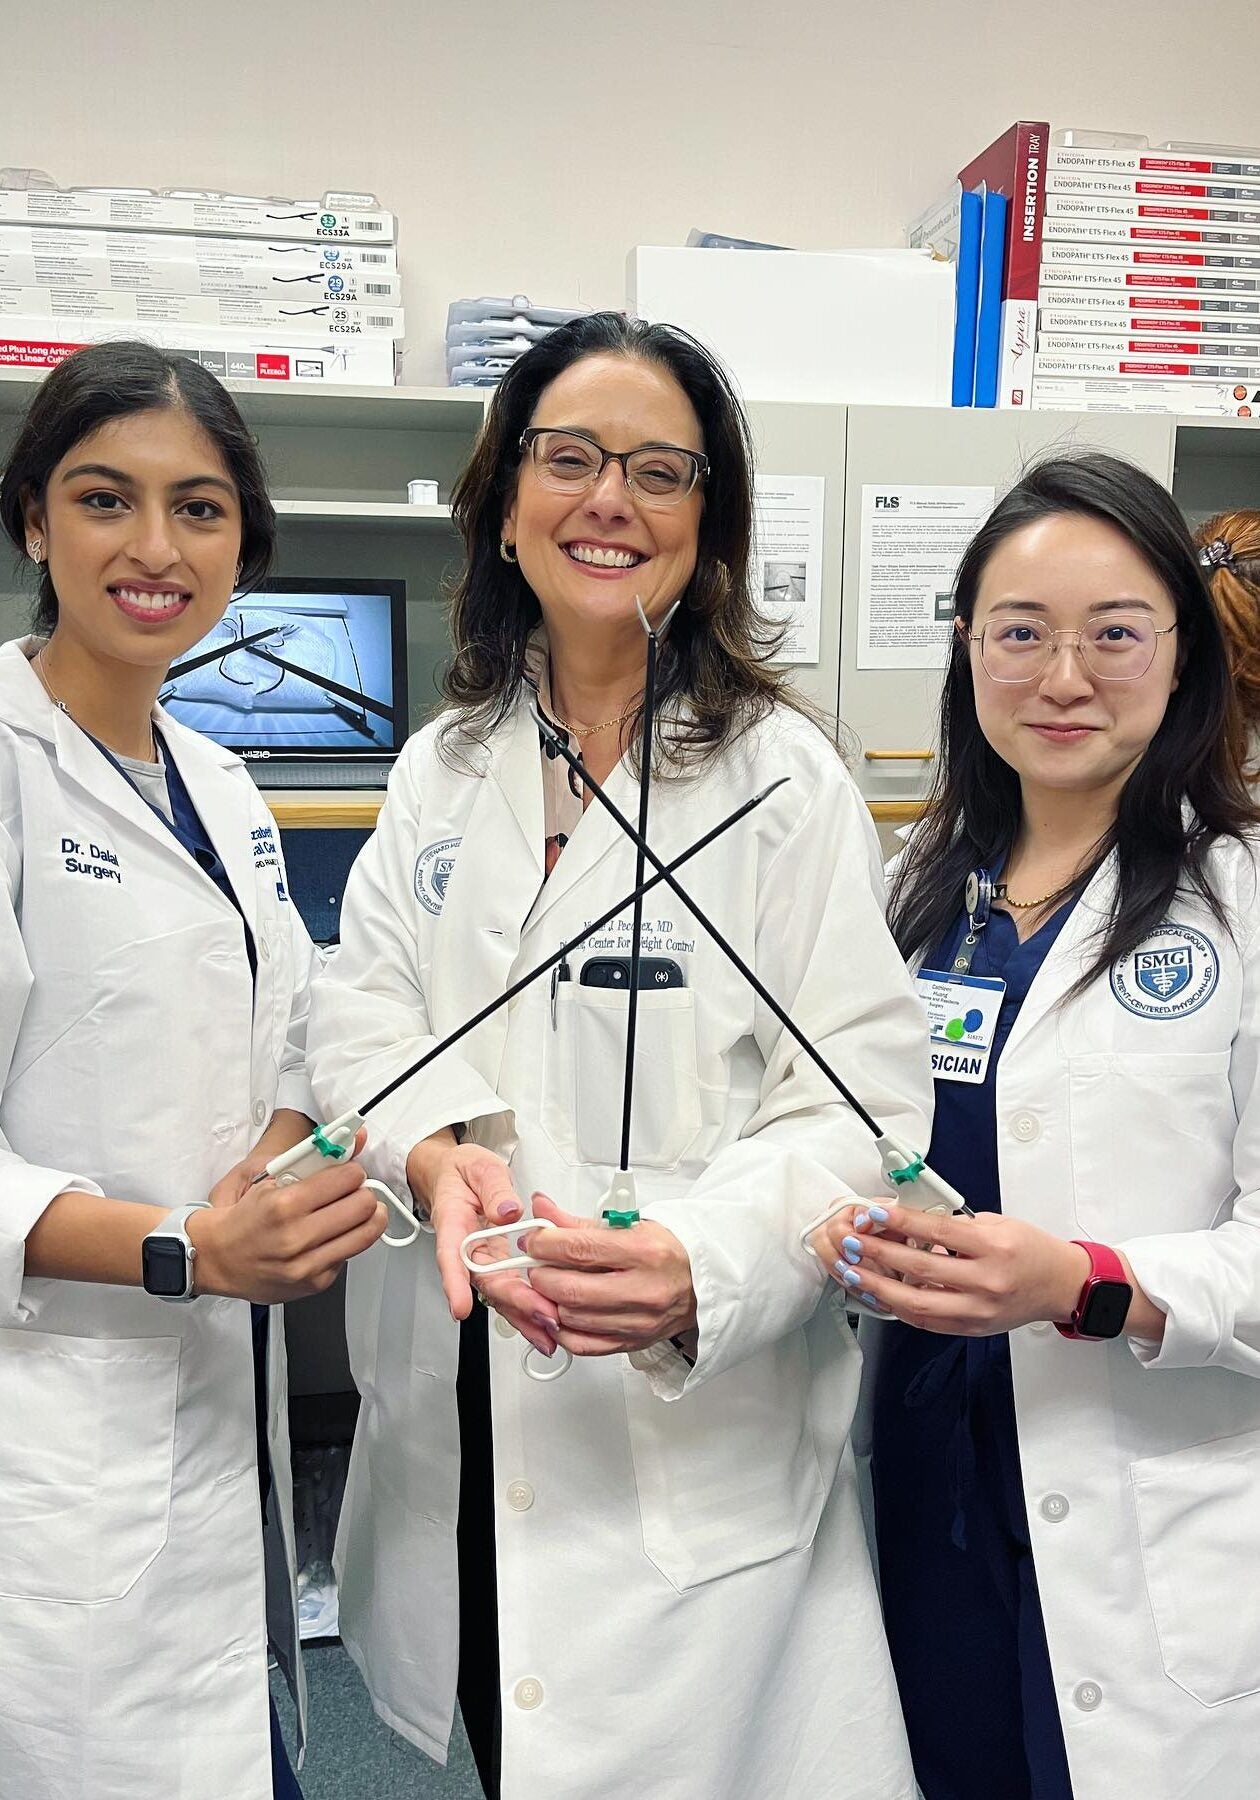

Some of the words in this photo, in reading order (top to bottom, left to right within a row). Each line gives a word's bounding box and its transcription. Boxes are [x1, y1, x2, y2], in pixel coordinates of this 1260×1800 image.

[1029, 133, 1040, 154] TRAY
[1023, 158, 1039, 242] INSERTION
[316, 228, 350, 236] ECS33A
[320, 262, 352, 270] ECS29A
[329, 279, 342, 287] 29
[335, 311, 347, 319] 25
[329, 325, 361, 333] ECS25A
[8, 345, 26, 353] Plus
[27, 346, 48, 356] Long
[0, 353, 19, 362] copic
[20, 354, 46, 362] Linear
[875, 496, 900, 508] FLS
[62, 838, 84, 855] Dr.
[65, 858, 121, 883] Surgery
[657, 920, 672, 932] MD
[589, 937, 615, 948] Center
[617, 937, 630, 948] For
[636, 936, 662, 952] eight
[666, 938, 695, 952] Control
[1184, 933, 1205, 952] GROUP
[1142, 951, 1184, 969] SMG
[931, 1054, 982, 1074] SICIAN
